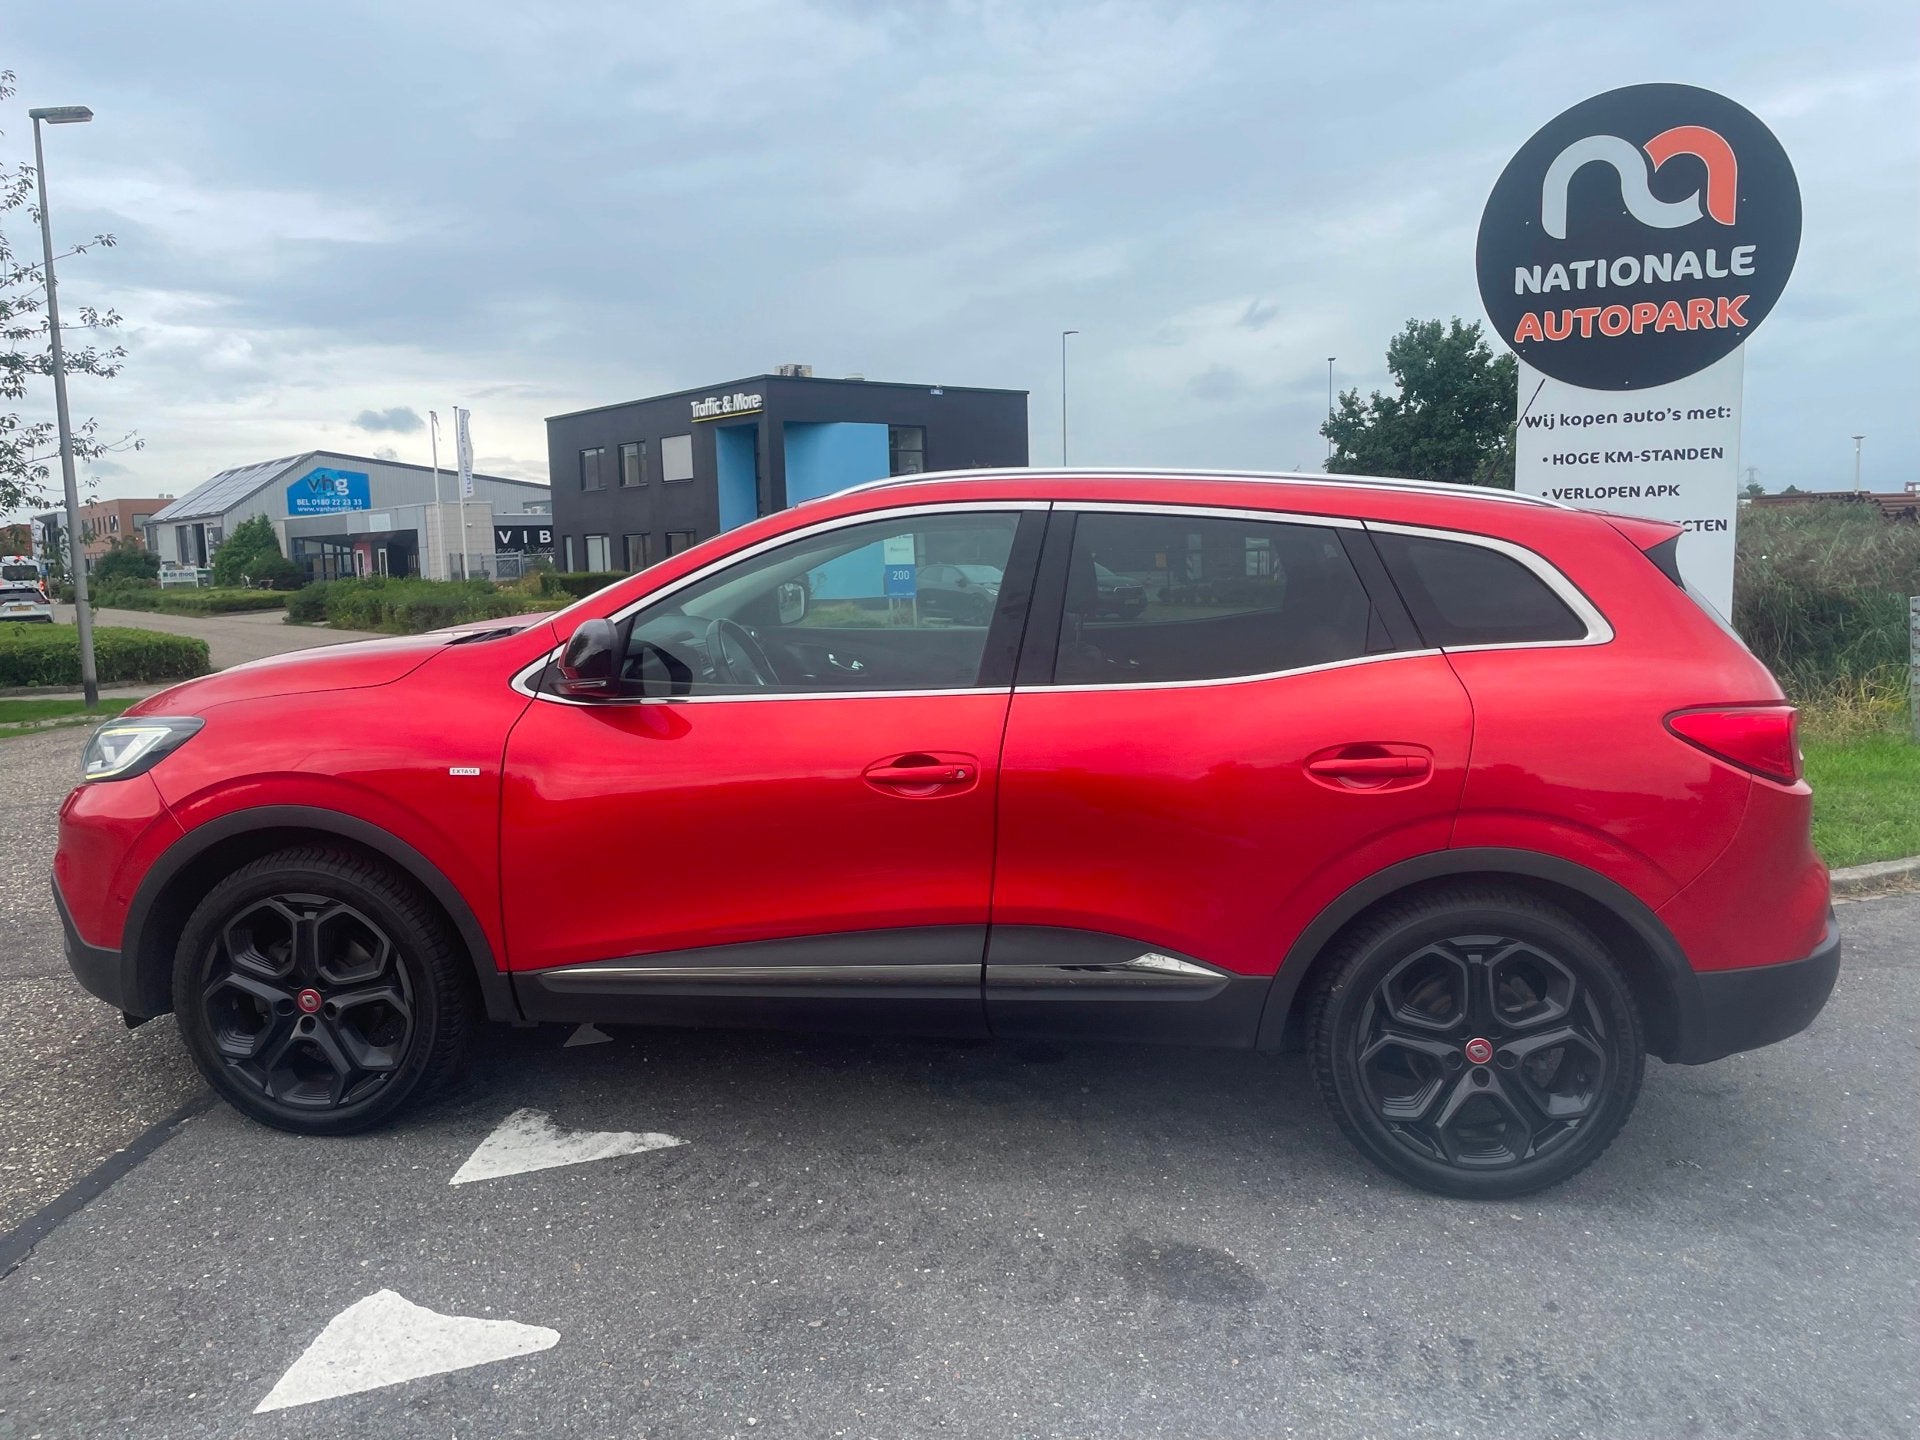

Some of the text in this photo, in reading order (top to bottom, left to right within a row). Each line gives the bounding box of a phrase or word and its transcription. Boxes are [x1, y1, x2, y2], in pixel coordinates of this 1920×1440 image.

[1514, 244, 1756, 295] NATIONALE
[1513, 294, 1751, 343] AUTOPARK
[690, 393, 763, 418] Traffic & More
[1525, 406, 1732, 430] Wij kopen auto's met:
[1552, 447, 1724, 466] HOGE KM-STANDEN
[307, 474, 350, 496] vhg
[1552, 484, 1681, 500] VERLOPEN APK
[296, 498, 311, 506] BEL
[331, 498, 341, 506] 22
[353, 498, 363, 506] 33
[498, 530, 552, 544] VIB
[892, 570, 910, 581] 200
